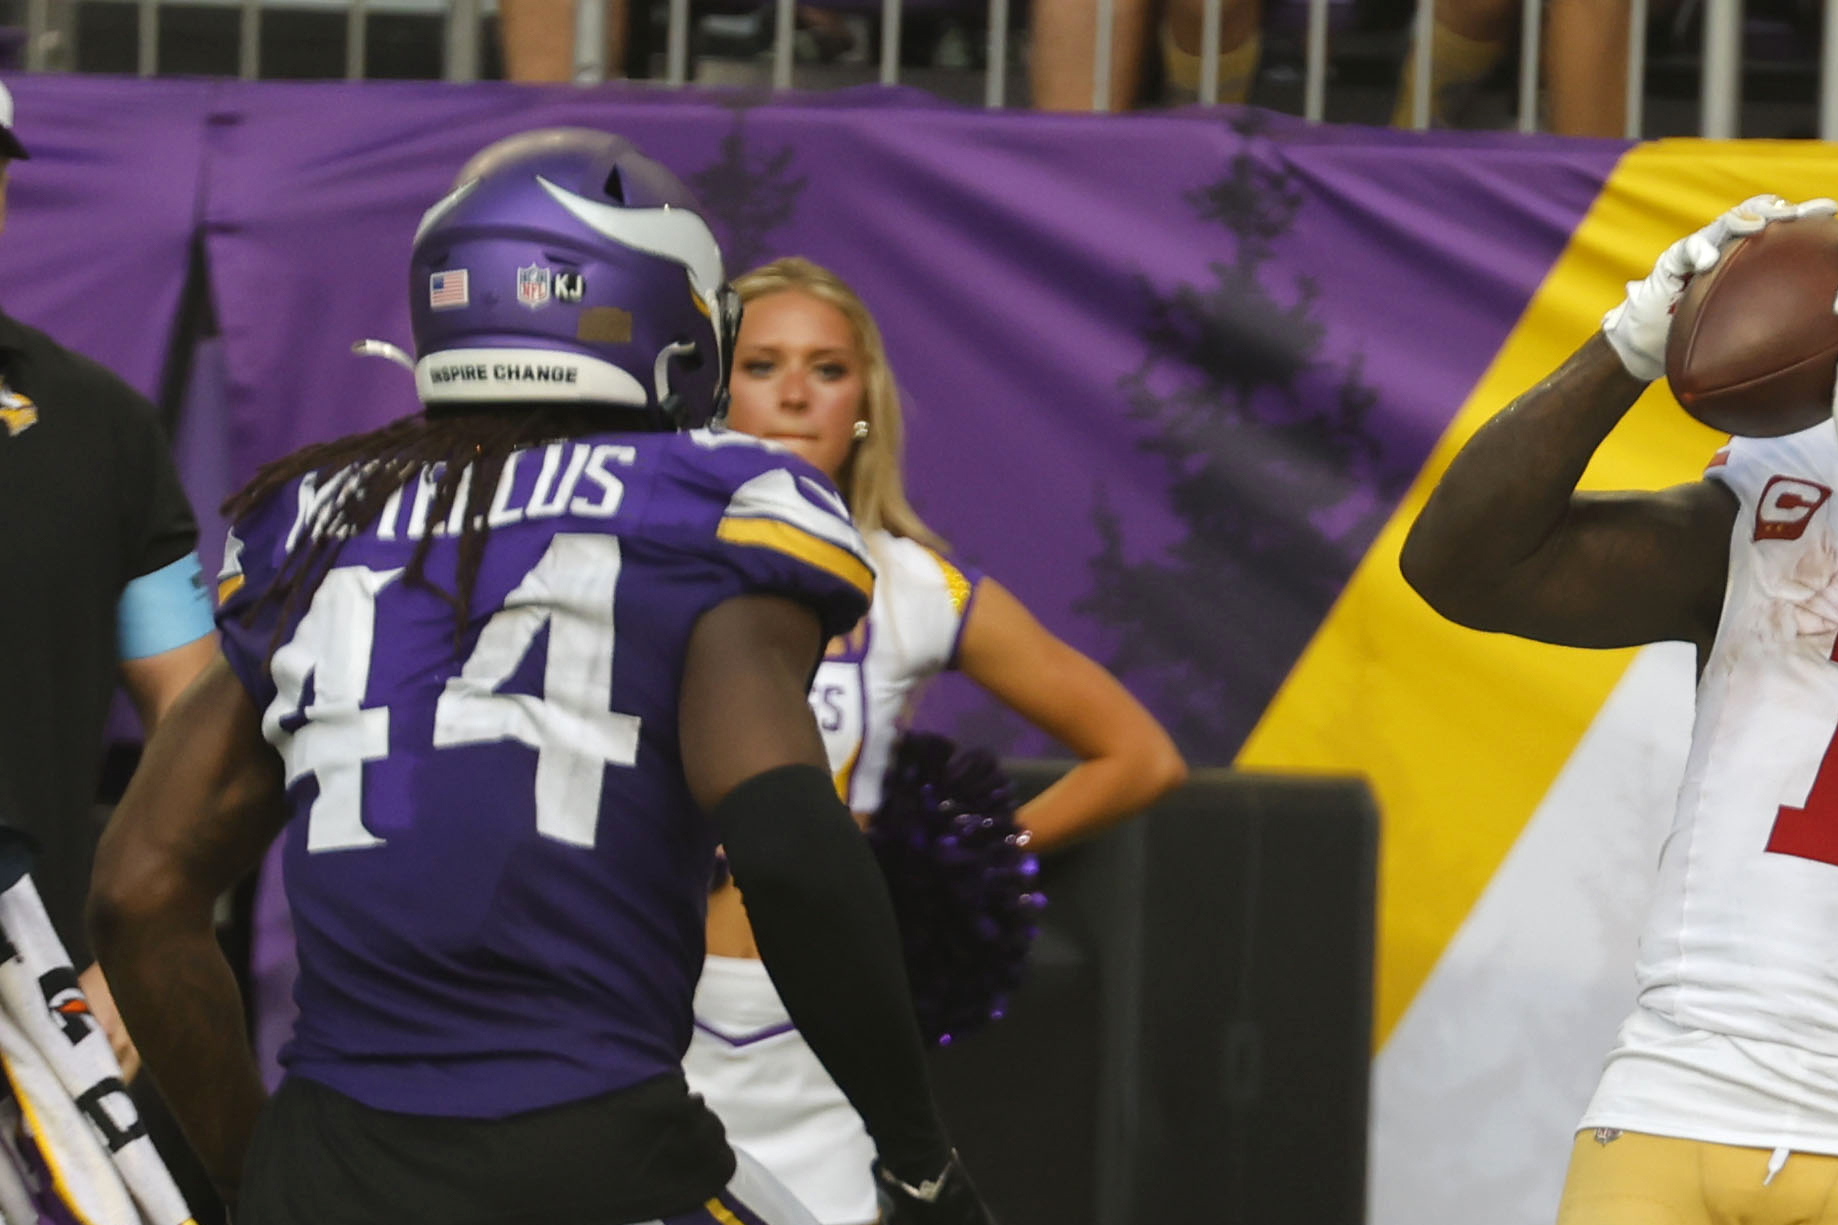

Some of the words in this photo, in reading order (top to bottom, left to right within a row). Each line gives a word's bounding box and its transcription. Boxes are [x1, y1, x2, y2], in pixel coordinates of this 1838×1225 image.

[554, 273, 583, 299] KJ
[430, 364, 487, 384] INSPIRE
[493, 363, 579, 384] CHANGE
[261, 532, 642, 854] 44
